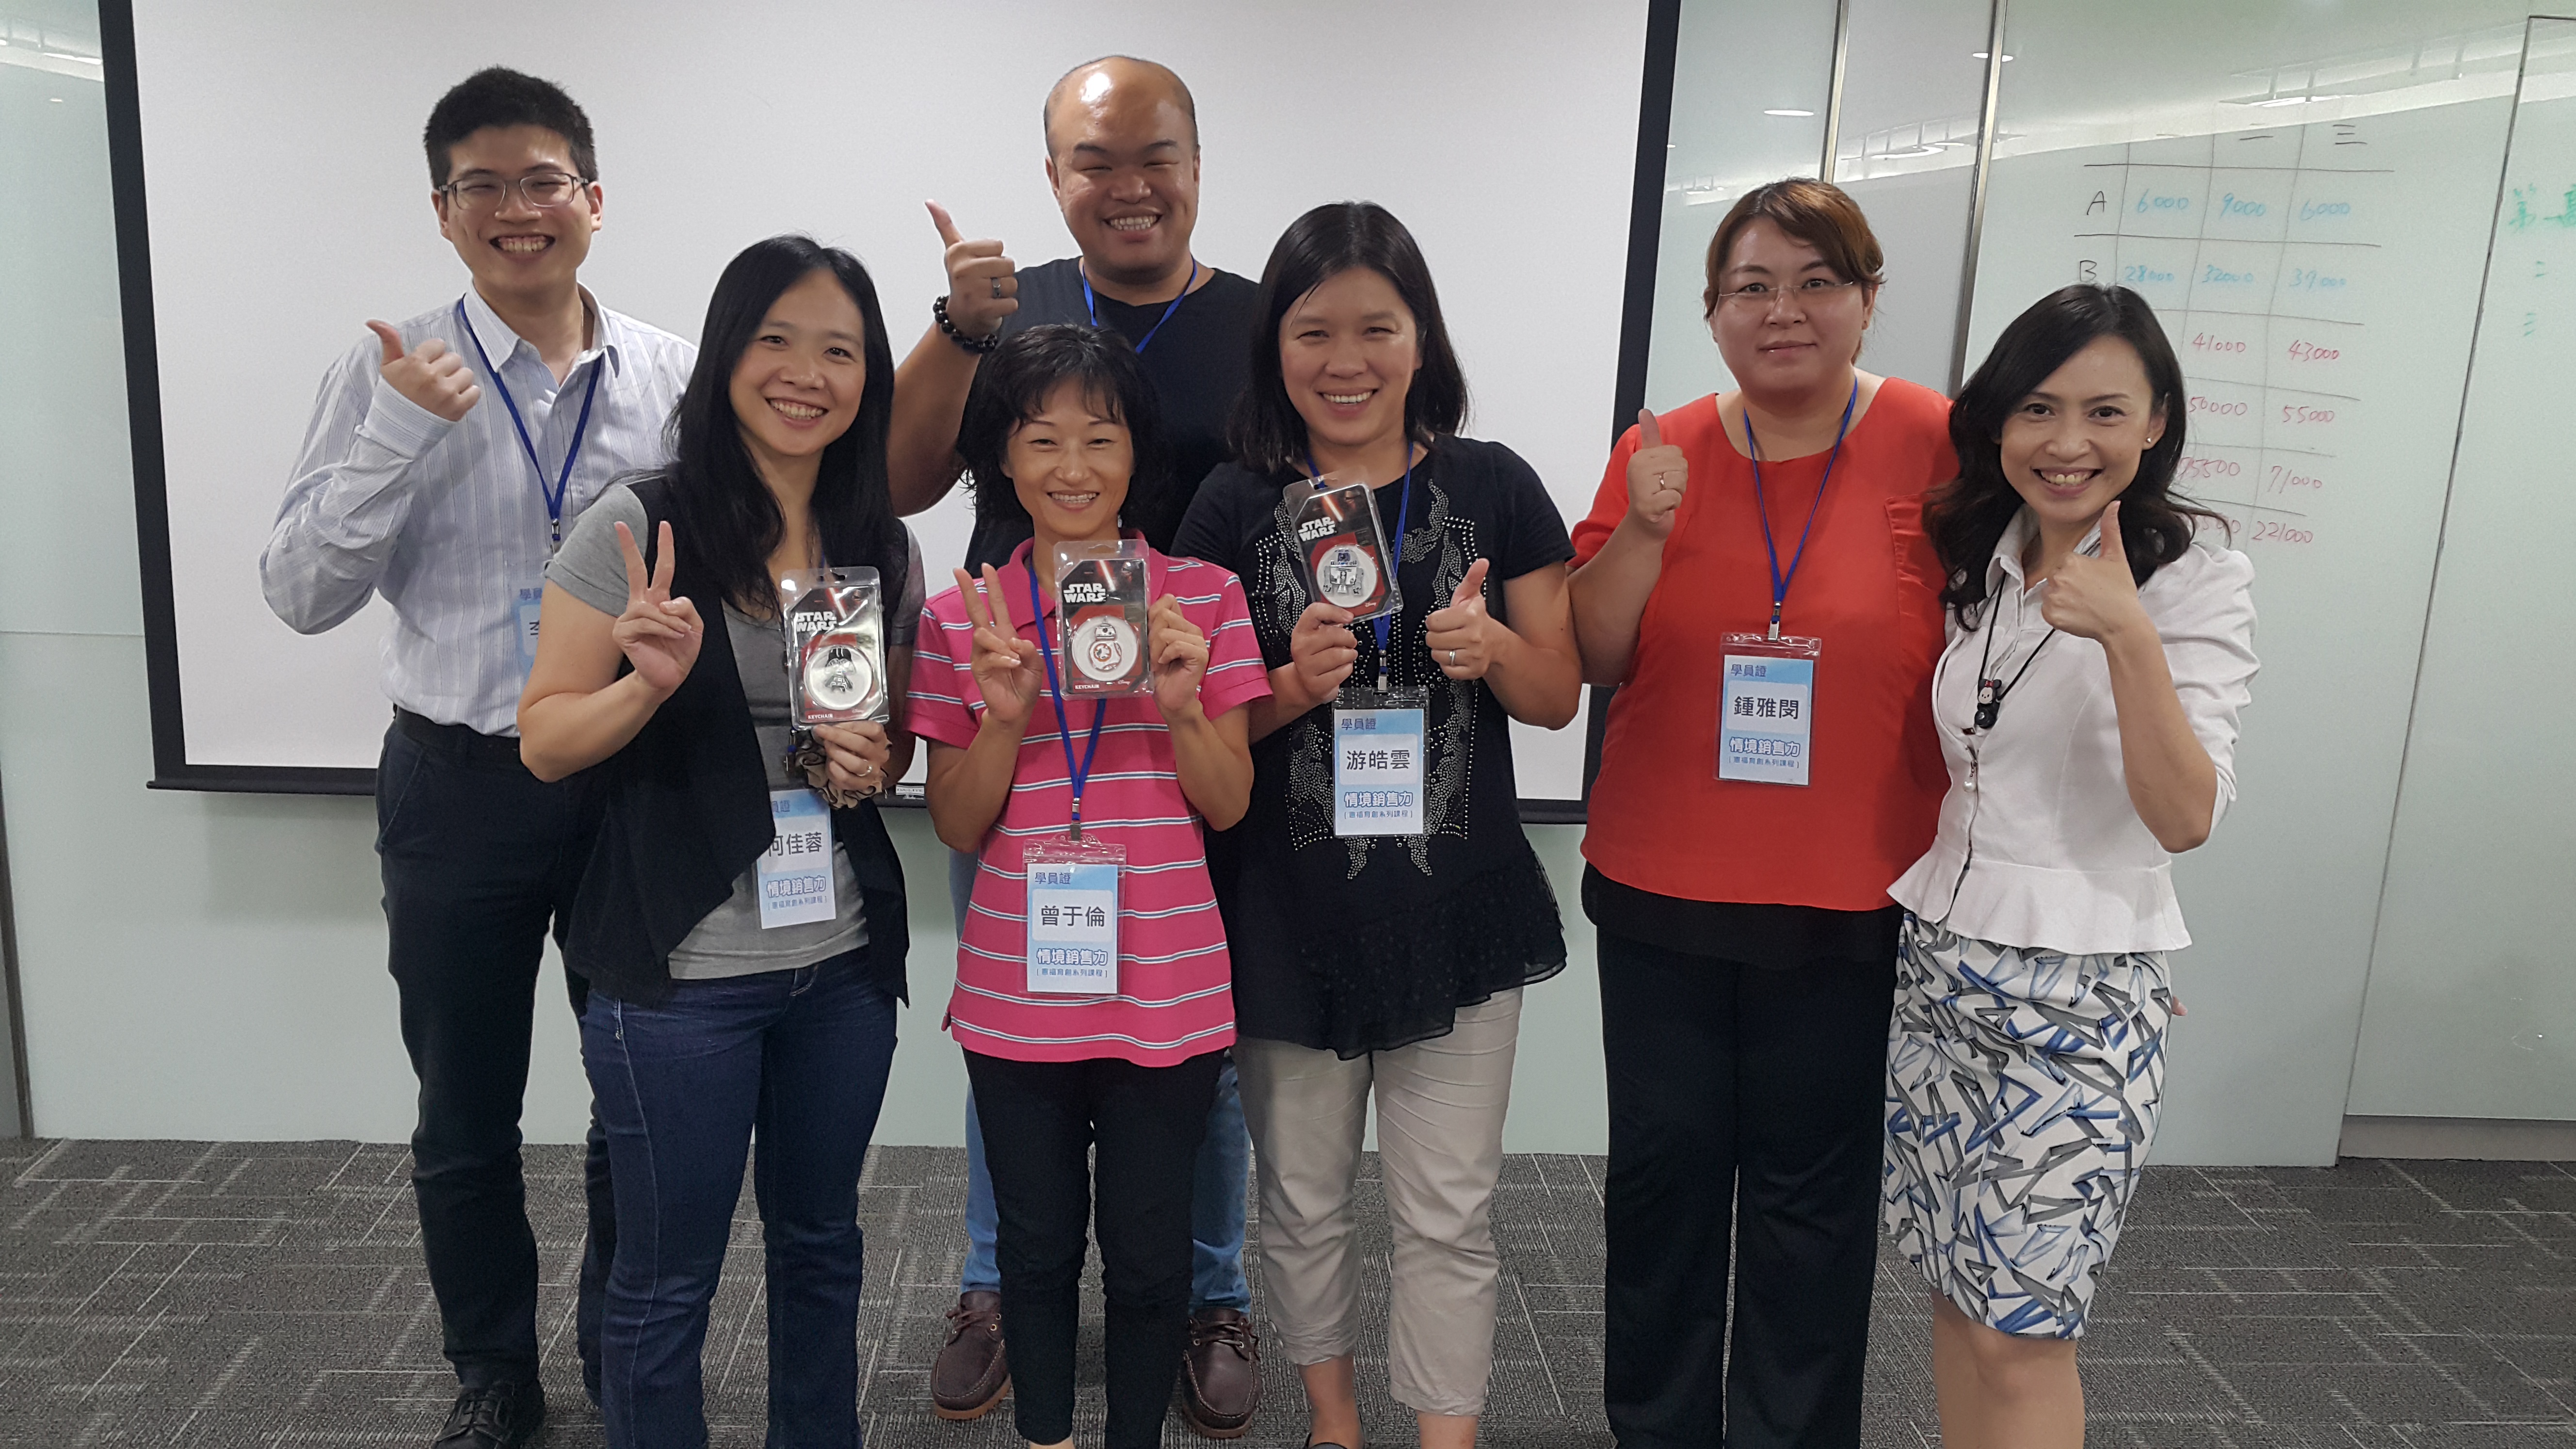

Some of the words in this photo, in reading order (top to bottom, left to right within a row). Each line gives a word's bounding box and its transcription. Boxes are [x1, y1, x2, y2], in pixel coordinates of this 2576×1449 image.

[2333, 124, 2368, 145] 三
[2087, 191, 2107, 215] A
[2138, 188, 2189, 213] 6000
[2219, 193, 2267, 220] 9000
[2301, 198, 2351, 221] 6000
[2079, 259, 2097, 282] B
[2125, 264, 2174, 282] 28000
[2202, 264, 2254, 283] 32000
[2192, 332, 2246, 353] 41000
[2288, 340, 2339, 361] 43000
[2189, 396, 2248, 416] 50000
[2283, 405, 2334, 423] 55000
[2267, 466, 2322, 493] 71000
[1298, 516, 1335, 533] STAR
[1299, 524, 1336, 542] WARS
[2252, 521, 2313, 543] 221000
[1063, 583, 1106, 593] STAR
[1064, 592, 1106, 603] WARS
[797, 611, 837, 622] STAR
[797, 621, 837, 632] WARS
[1731, 664, 1767, 677] 學員證
[1734, 696, 1799, 720] 鍾雅閔
[1341, 718, 1376, 730] 學員證
[1729, 737, 1801, 757] 情境銷售力
[1346, 750, 1410, 770] 游皓雲
[1344, 791, 1413, 808] 情境銷售力
[768, 831, 822, 857] 何佳蓉
[767, 875, 826, 898] 情境銷售力
[1034, 872, 1071, 885] 學員證
[1041, 905, 1105, 927] 曾于倫
[1036, 948, 1108, 966] 情境銷售力
